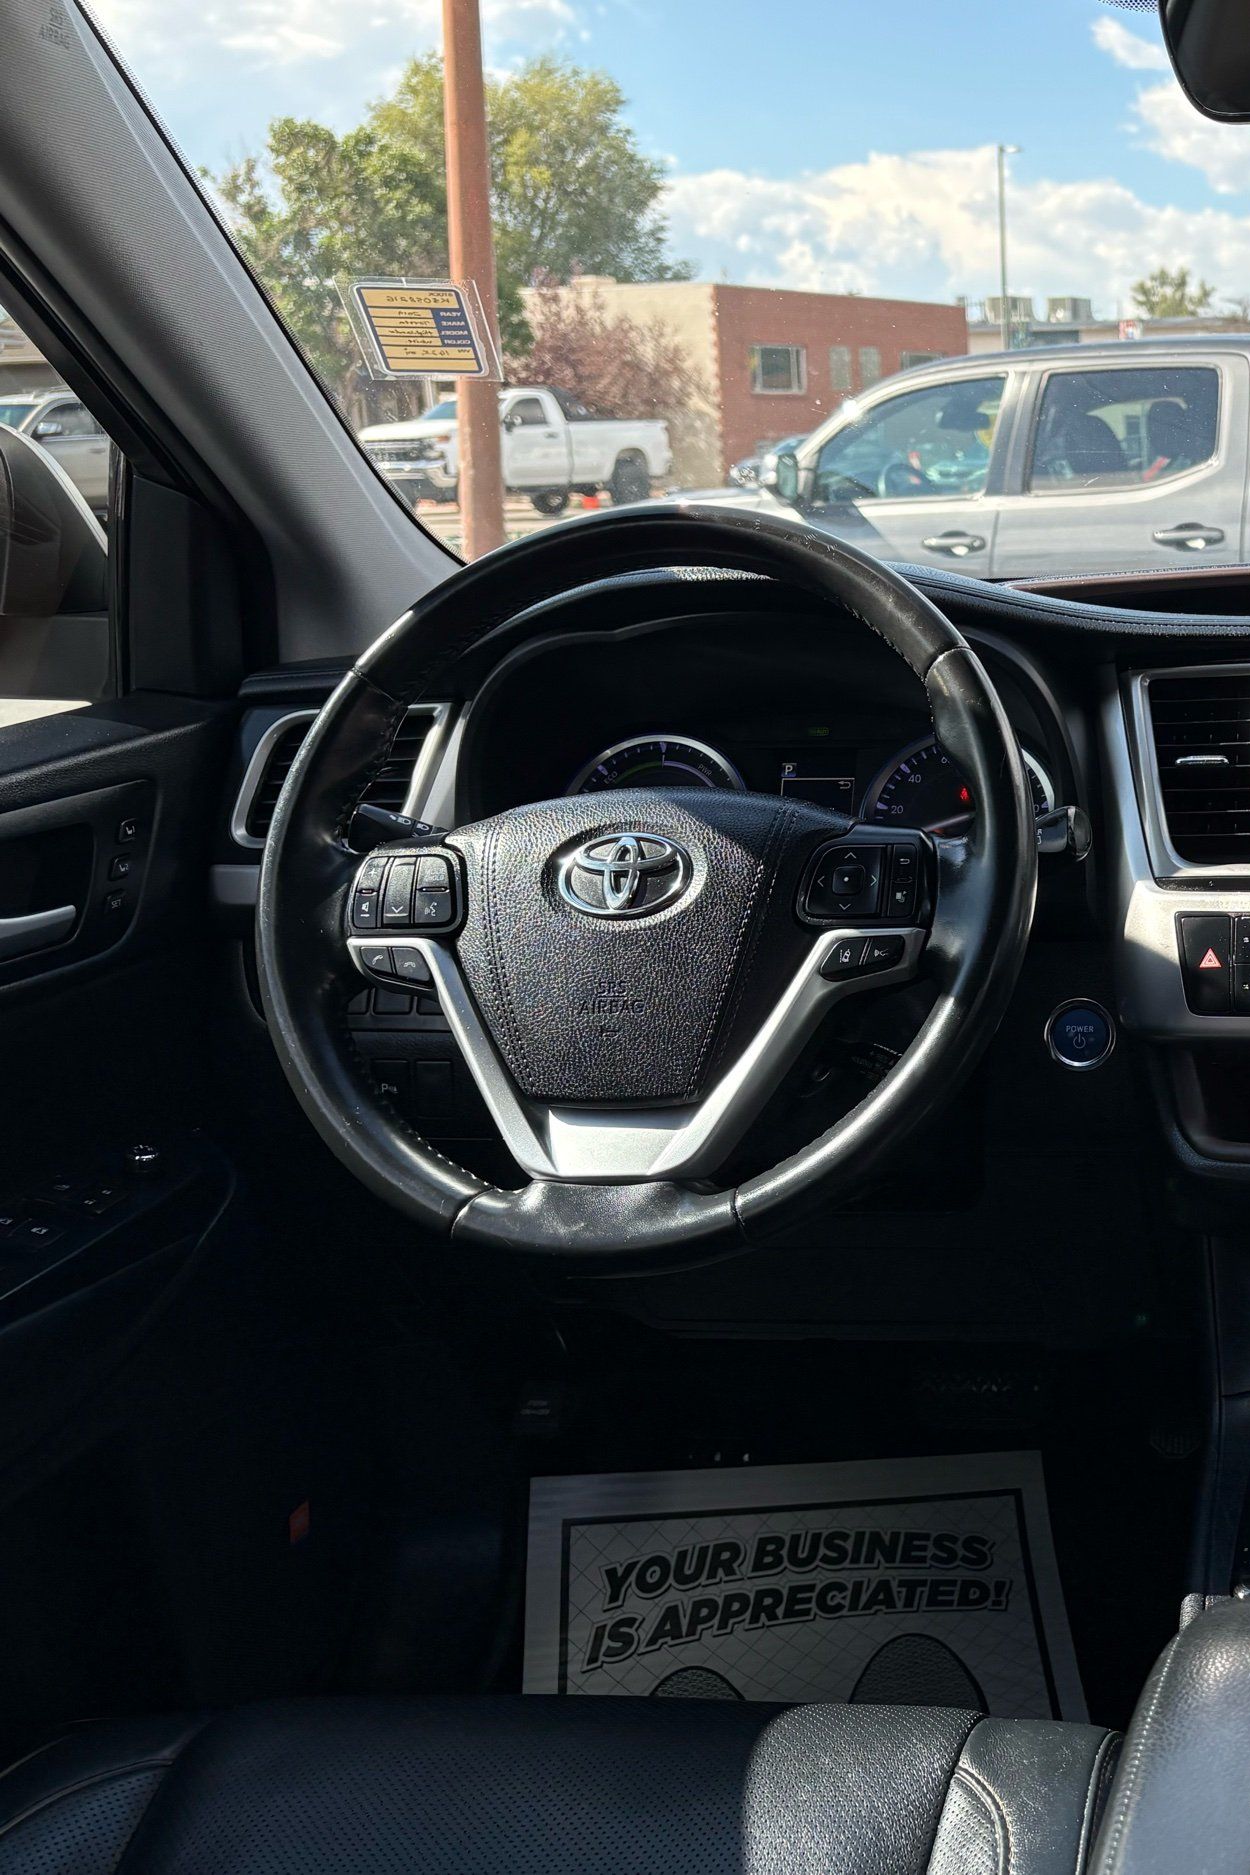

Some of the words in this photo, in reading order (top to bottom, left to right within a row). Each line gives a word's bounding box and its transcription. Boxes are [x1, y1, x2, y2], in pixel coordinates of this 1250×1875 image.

[907, 773, 922, 784] 40
[890, 804, 904, 814] 20
[579, 1000, 645, 1014] AIRBAG
[1065, 1025, 1095, 1033] POWER
[601, 1538, 745, 1605] YOUR
[753, 1529, 996, 1570] BUSINESS
[583, 1616, 642, 1668] IS
[646, 1576, 1011, 1648] APPRECIATED!
